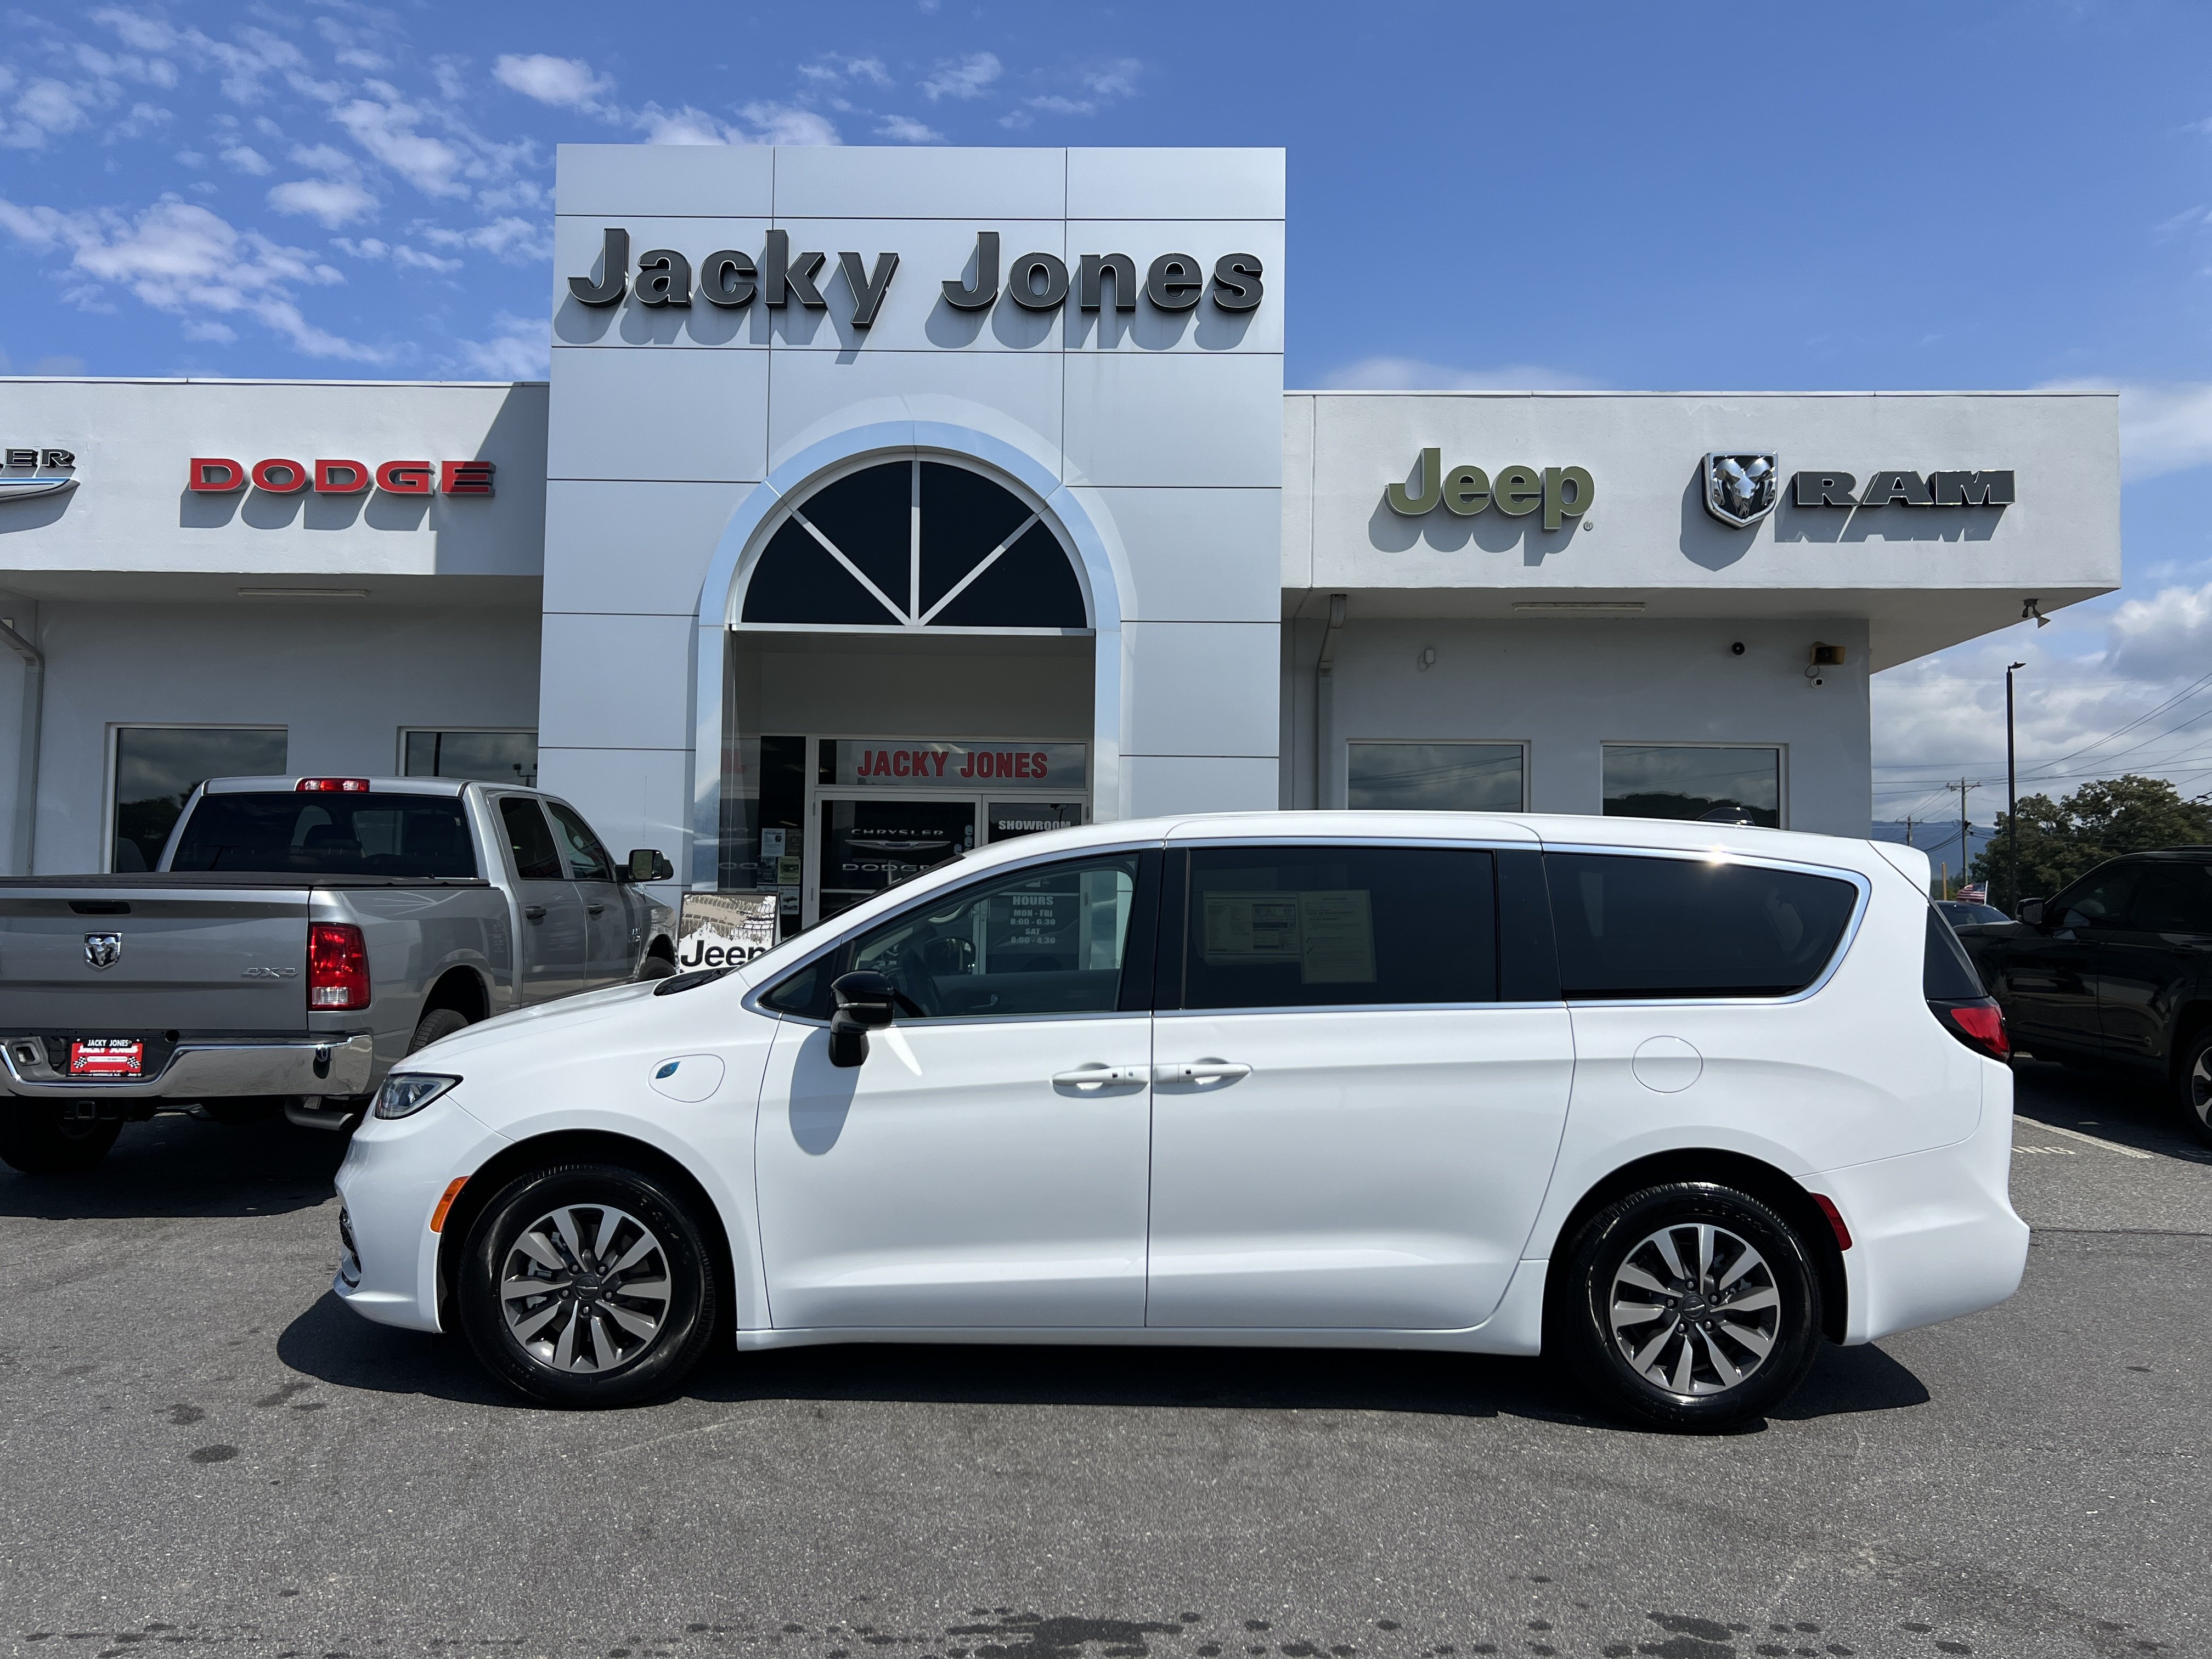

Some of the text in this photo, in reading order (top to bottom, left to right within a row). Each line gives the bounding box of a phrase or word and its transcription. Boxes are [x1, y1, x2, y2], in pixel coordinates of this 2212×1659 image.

[567, 228, 1263, 329] Jacky Jones
[0, 448, 76, 469] ER
[189, 458, 496, 496] DODGE
[1385, 447, 1595, 531] Jeep
[1792, 470, 2016, 508] RAM
[857, 750, 1048, 779] JACKY JONES
[998, 820, 1071, 830] SHOWROOM
[1012, 896, 1054, 905] HOURS
